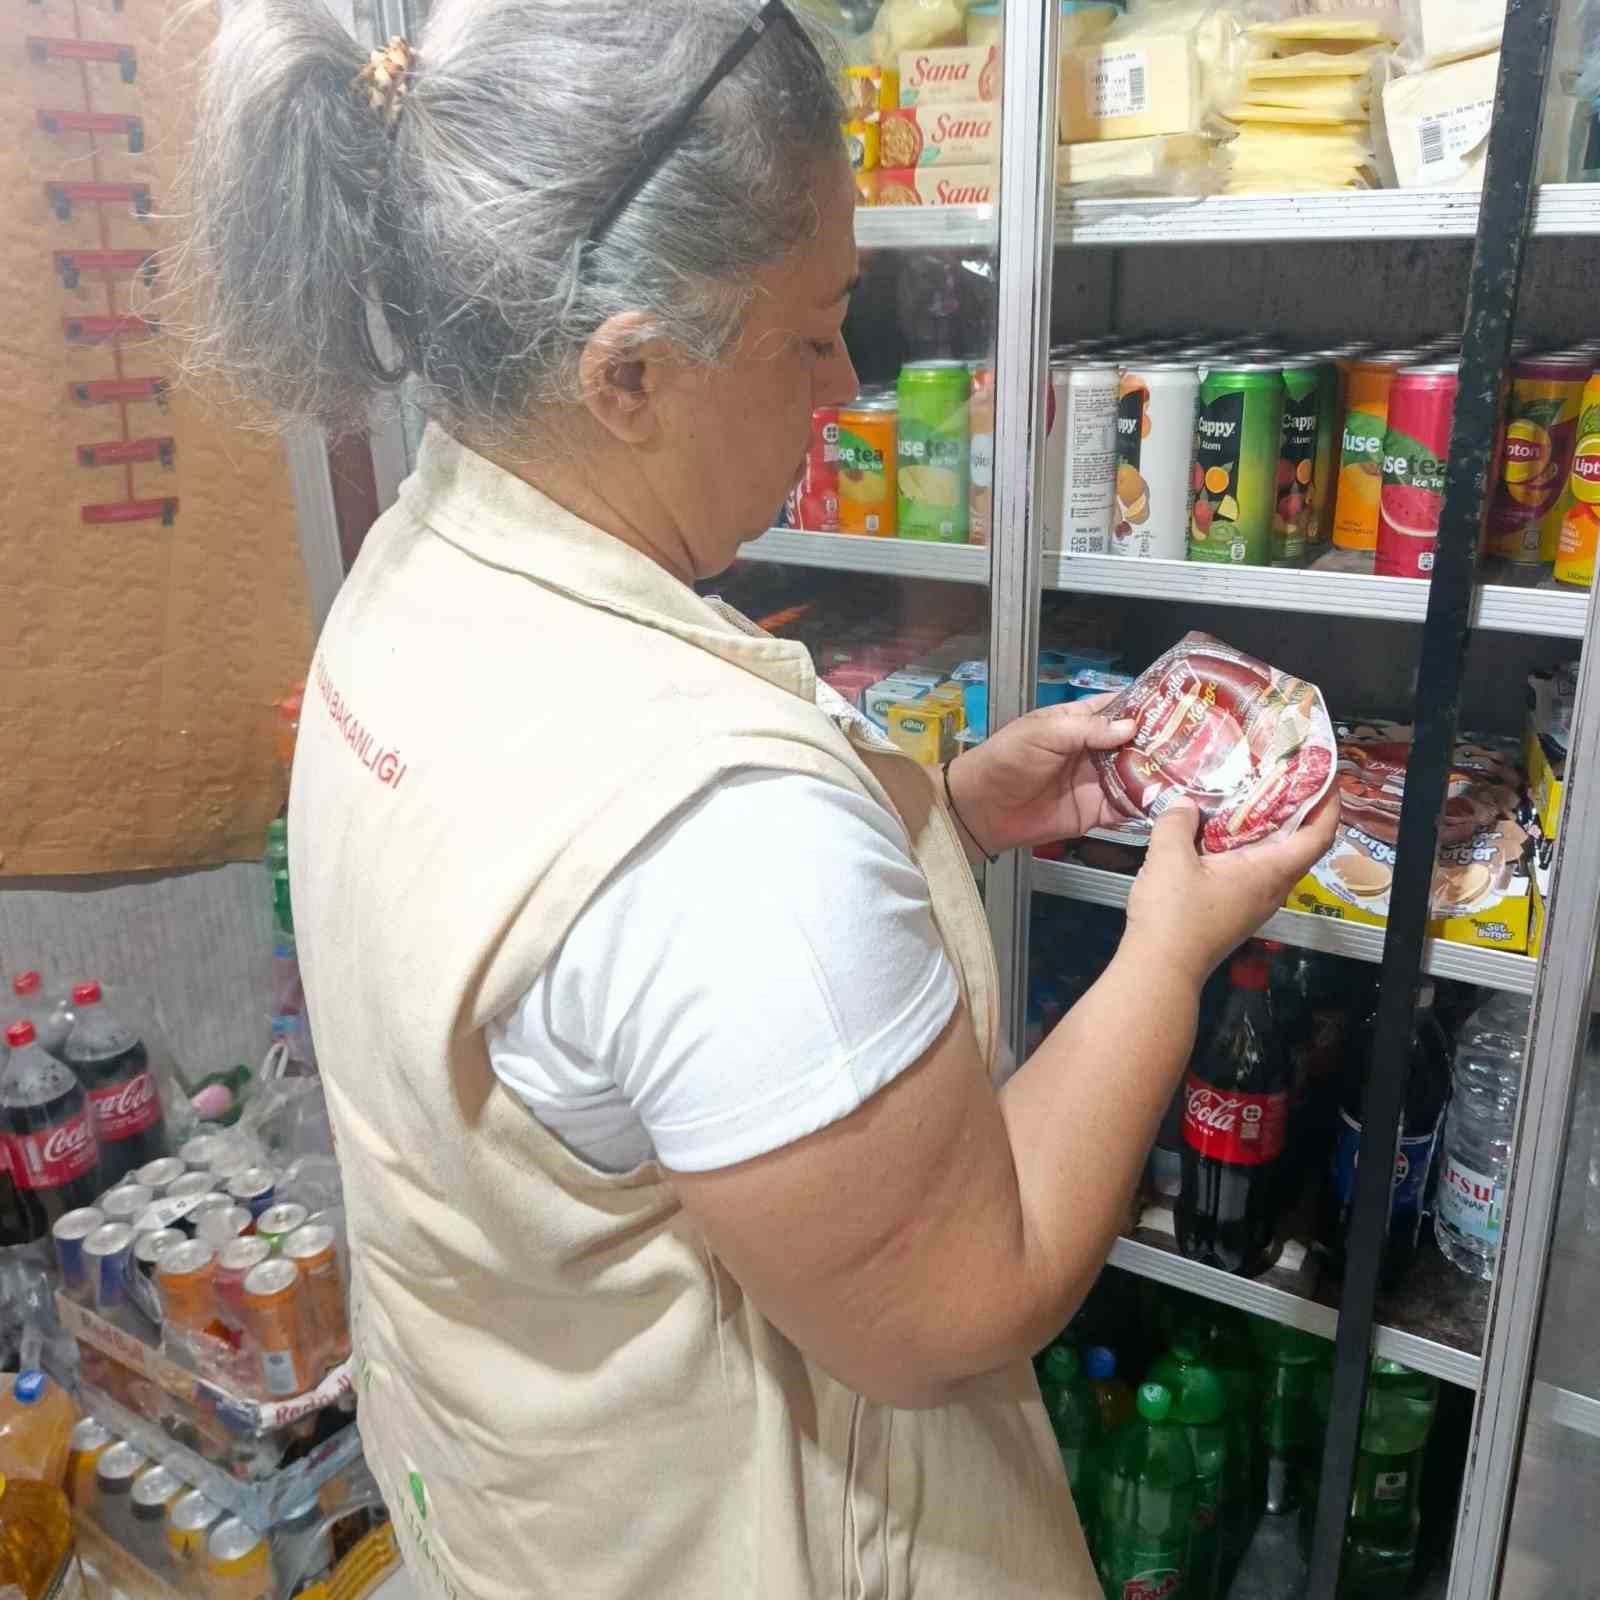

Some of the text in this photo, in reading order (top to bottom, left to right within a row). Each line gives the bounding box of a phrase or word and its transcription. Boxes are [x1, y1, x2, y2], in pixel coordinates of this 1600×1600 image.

[909, 56, 970, 87] Sana
[931, 112, 992, 144] Sana
[932, 179, 991, 205] Sana
